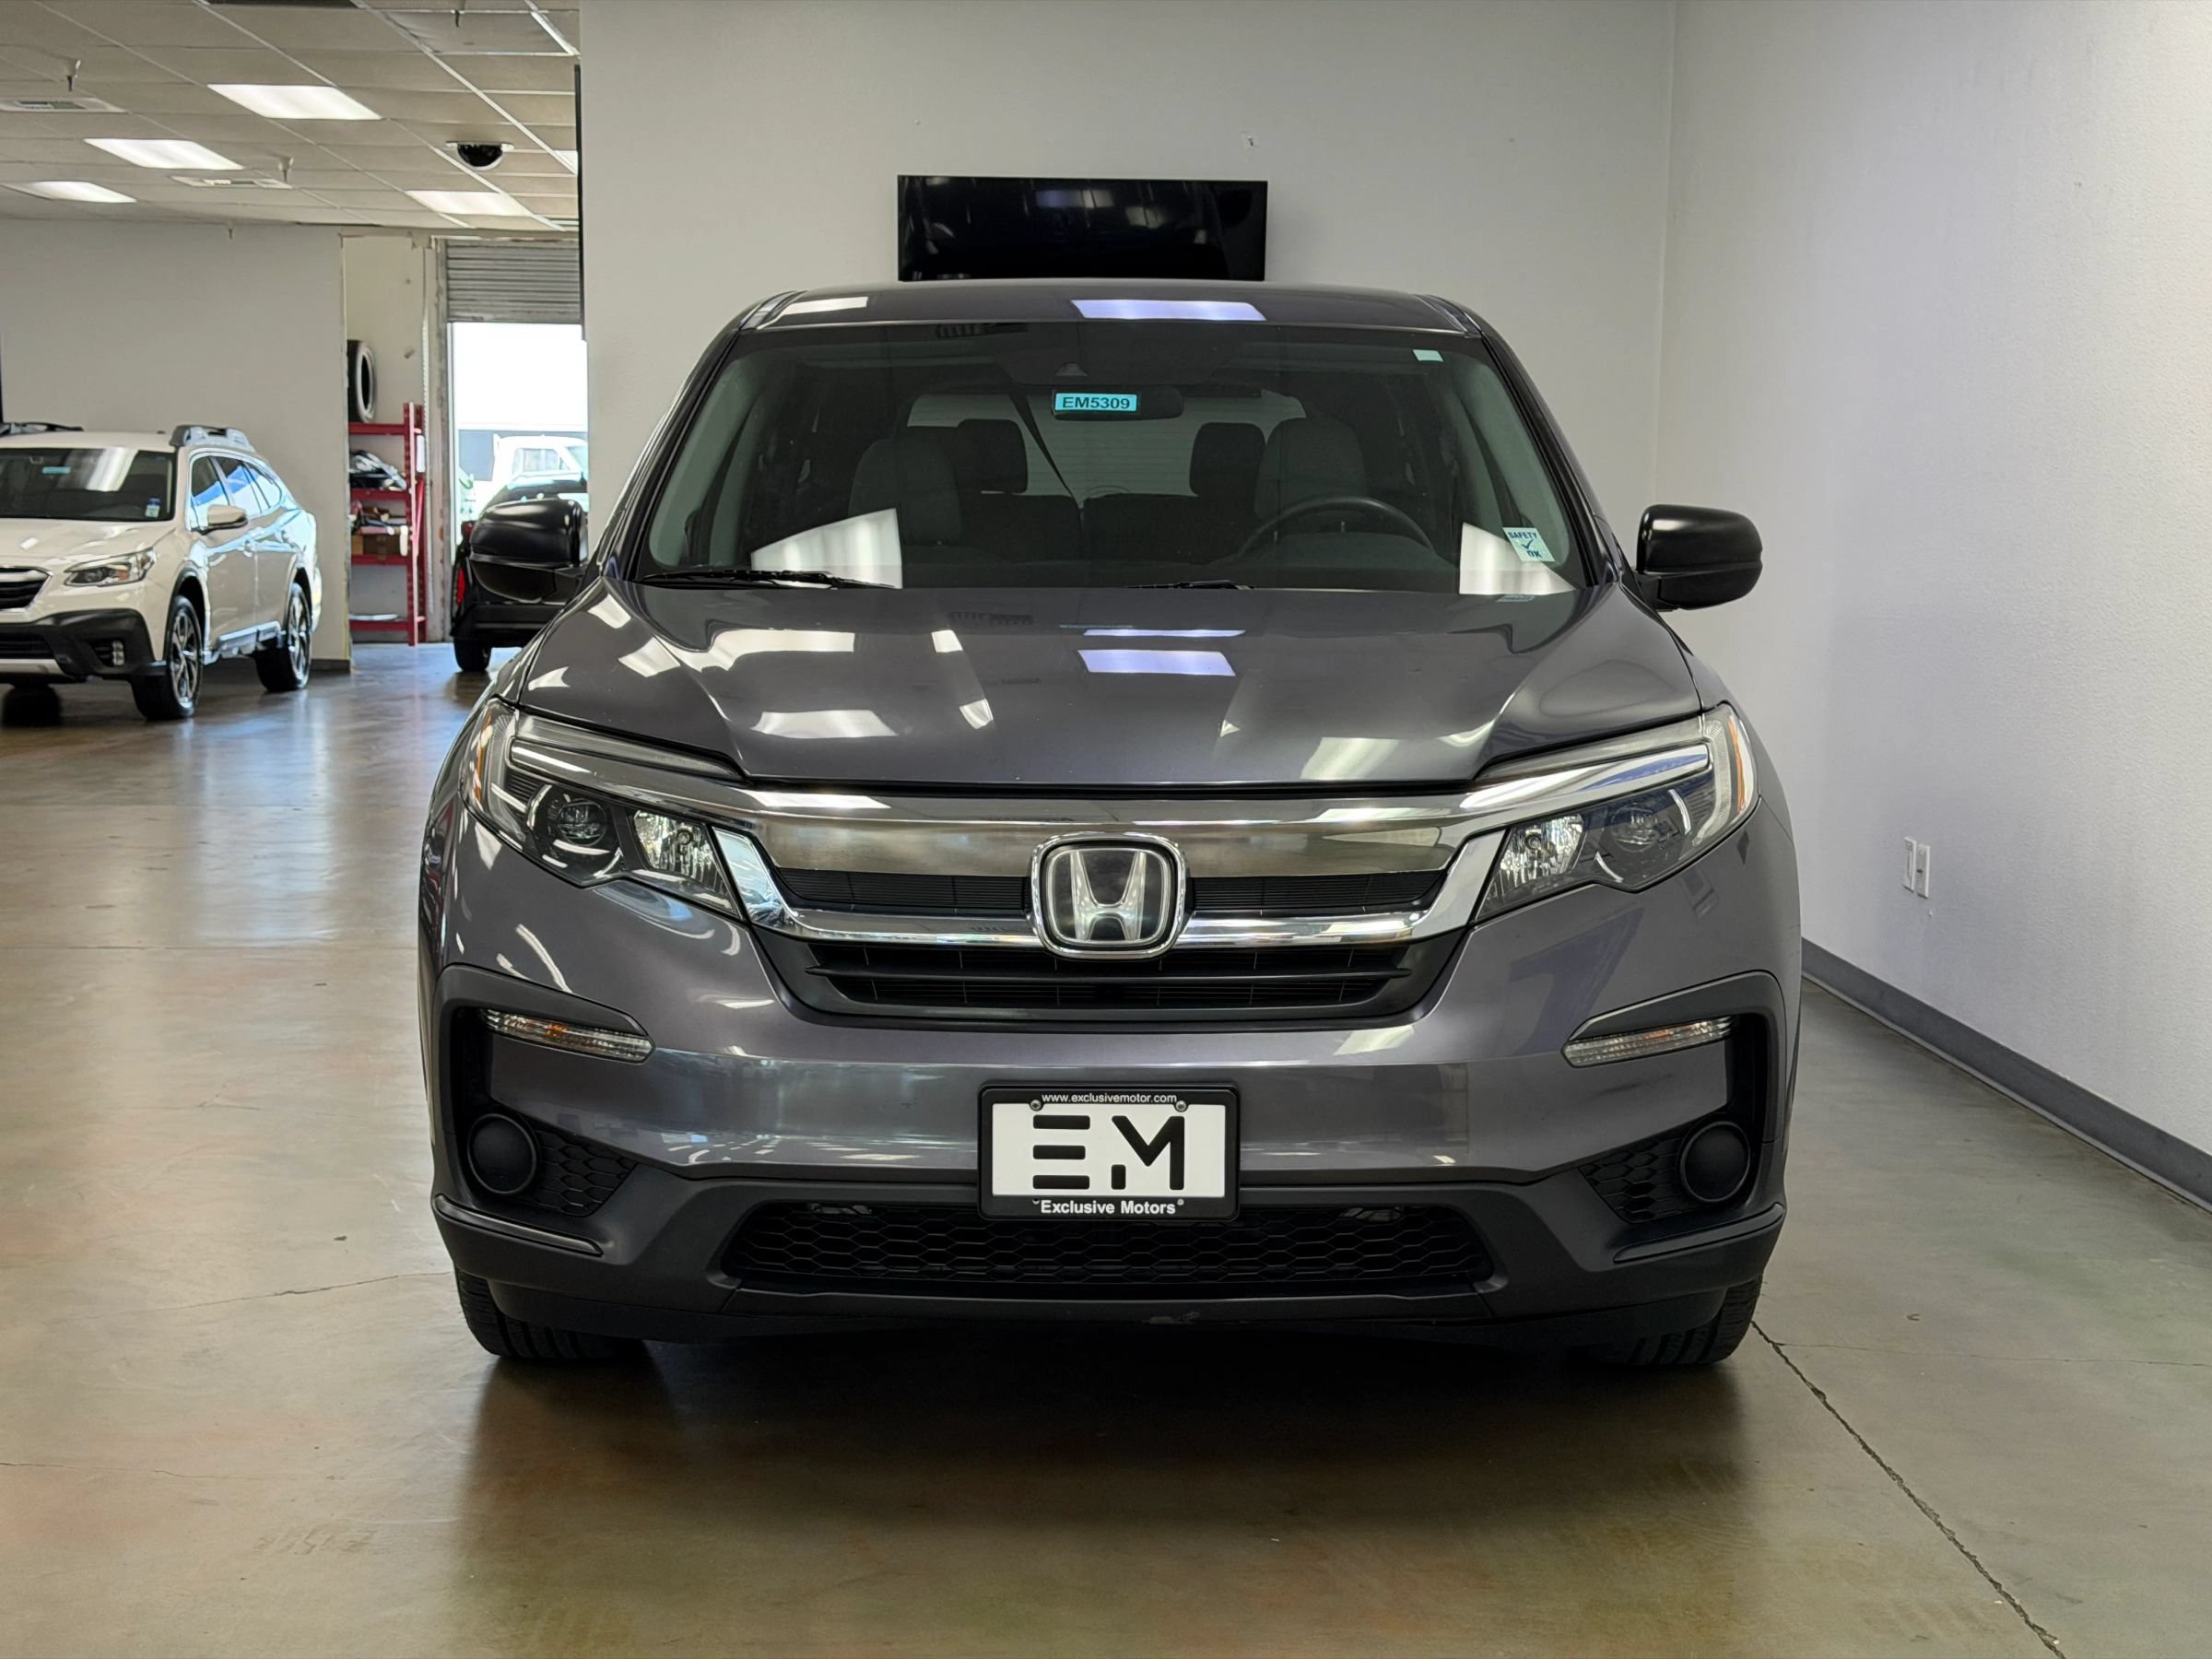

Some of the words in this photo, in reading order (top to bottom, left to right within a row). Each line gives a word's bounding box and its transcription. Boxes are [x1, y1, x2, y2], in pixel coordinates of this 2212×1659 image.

[1062, 396, 1130, 409] EM5309
[1507, 531, 1537, 539] SAFETY
[1041, 1092, 1177, 1103] www.exclusivemotor.com
[1041, 1199, 1115, 1215] Exclusive
[1120, 1200, 1176, 1215] Motors
